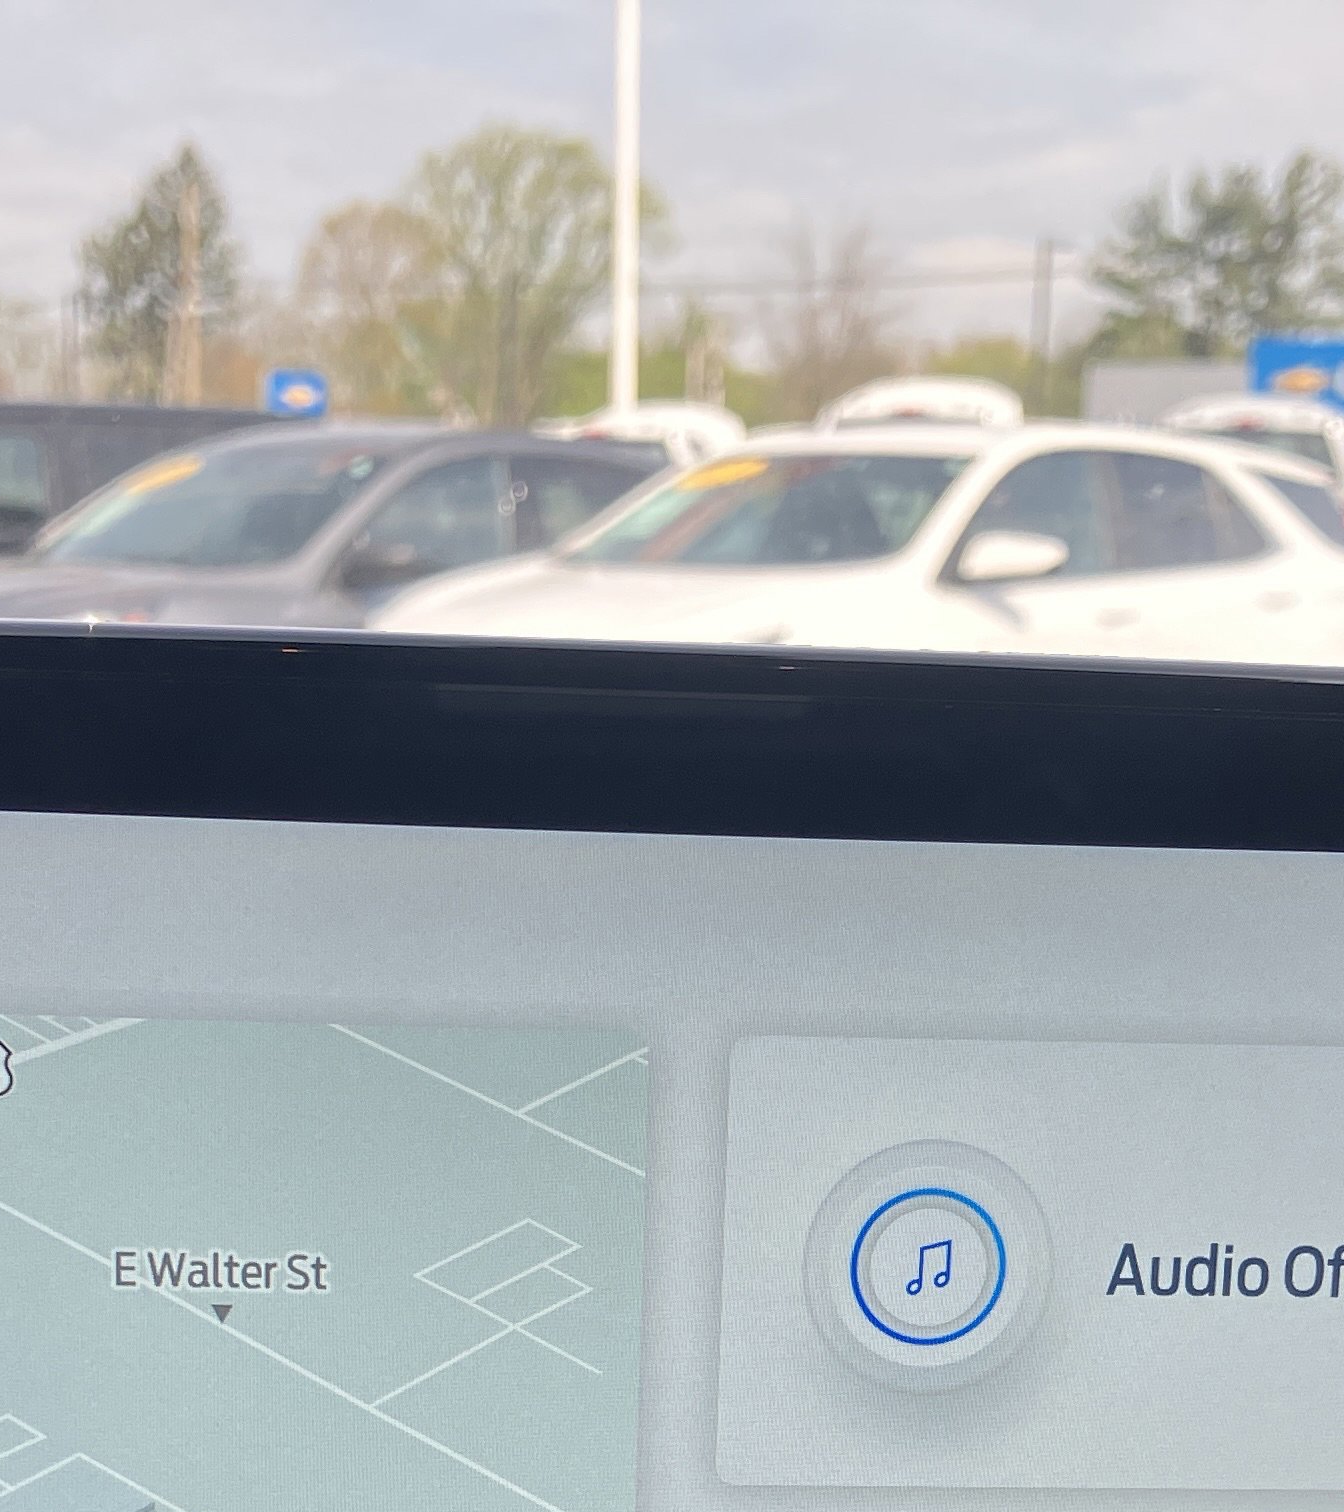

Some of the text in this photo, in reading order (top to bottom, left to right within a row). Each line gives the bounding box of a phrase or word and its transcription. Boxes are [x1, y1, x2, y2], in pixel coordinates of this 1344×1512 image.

[115, 1251, 327, 1290] E Walter St
[1105, 1242, 1270, 1297] Audio
